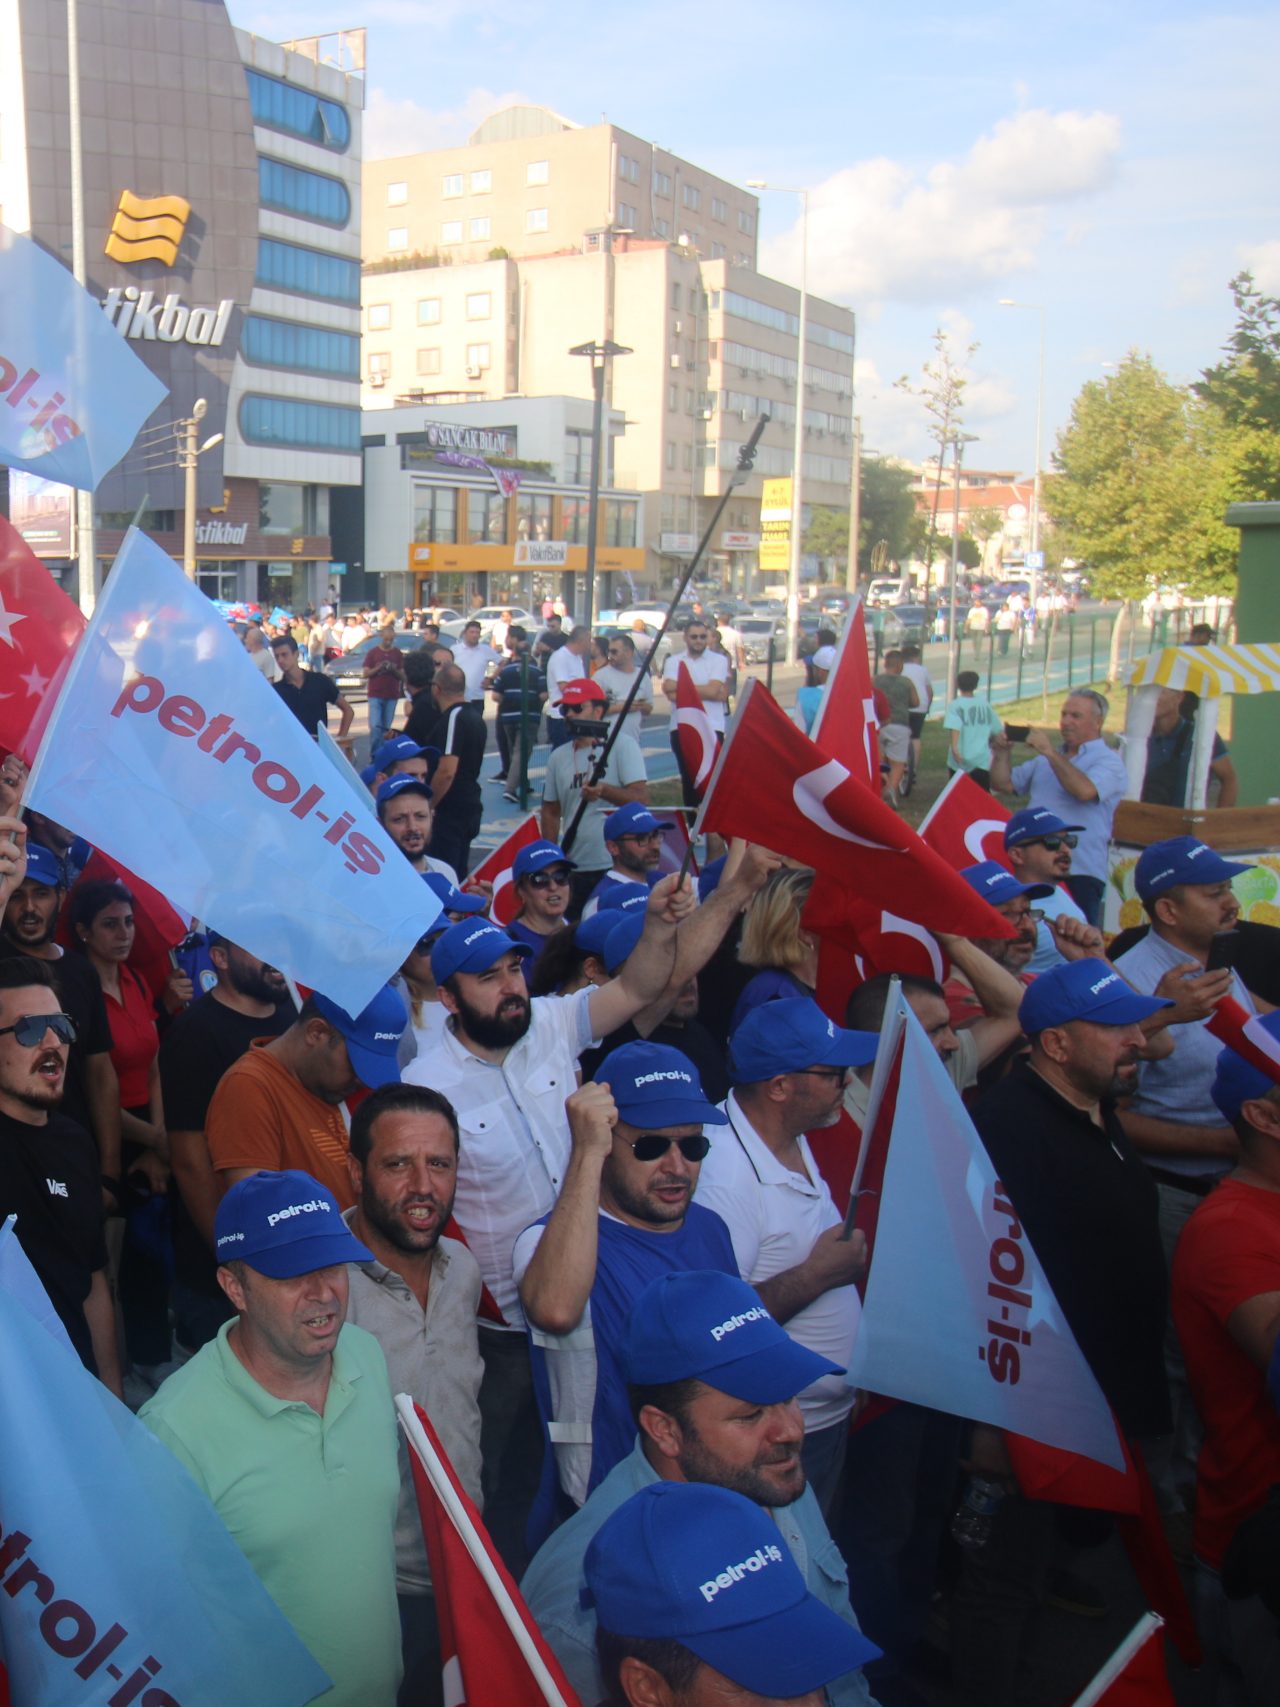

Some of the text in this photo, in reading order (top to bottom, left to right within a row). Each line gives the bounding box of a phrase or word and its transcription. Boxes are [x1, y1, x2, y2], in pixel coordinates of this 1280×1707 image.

[102, 286, 234, 346] tikbal
[438, 427, 478, 449] SANCAK
[110, 672, 386, 876] petrol-iş
[267, 1199, 331, 1227] petrol-iş
[979, 1180, 1033, 1386] rol-iş
[699, 1544, 783, 1603] petrol-iş
